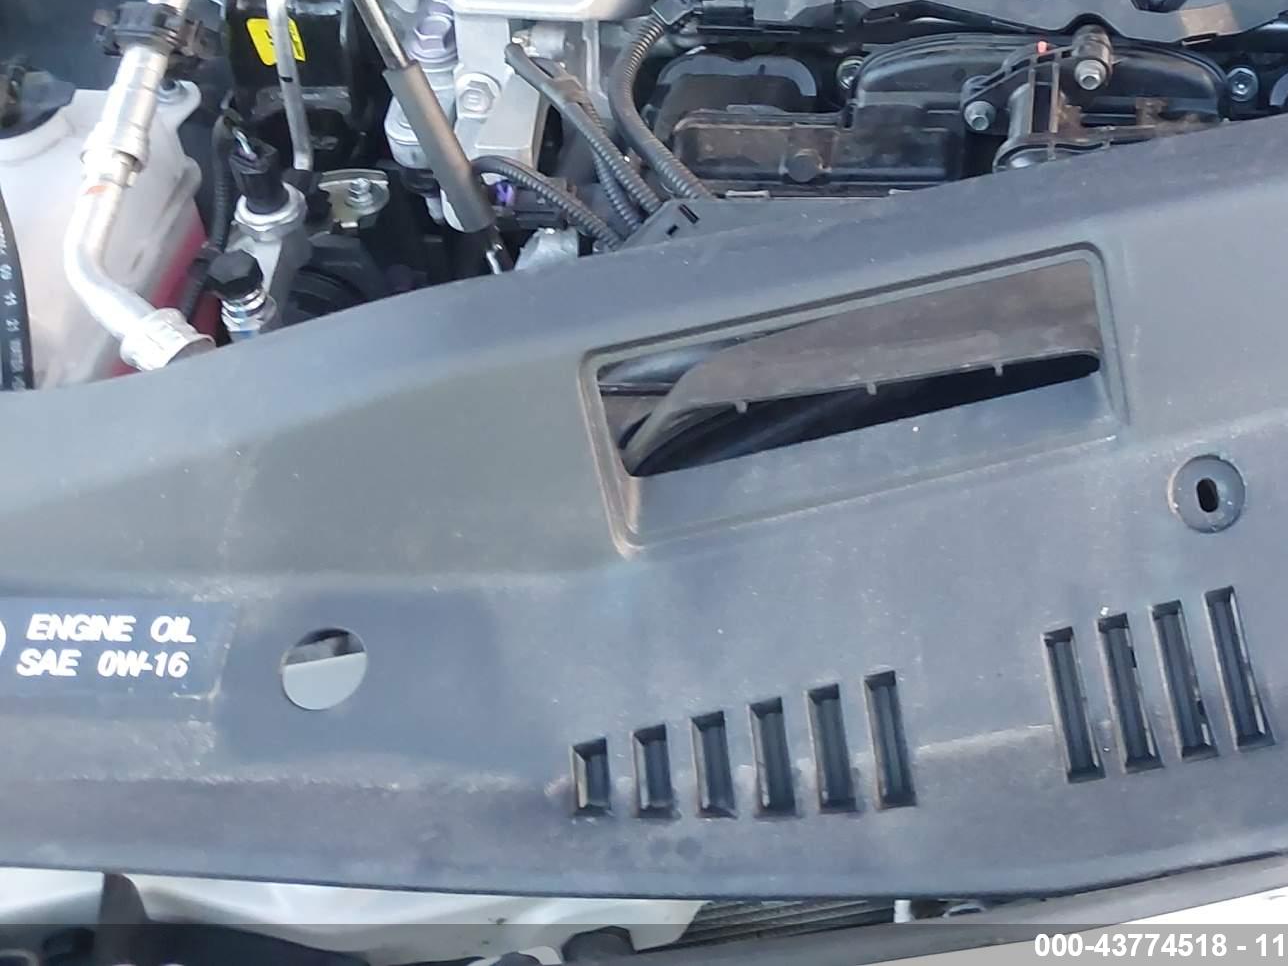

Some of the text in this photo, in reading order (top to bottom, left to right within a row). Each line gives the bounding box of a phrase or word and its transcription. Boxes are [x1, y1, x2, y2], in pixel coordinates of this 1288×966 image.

[26, 613, 197, 643] ENGINE OIL
[16, 648, 190, 678] SAE 0W-16
